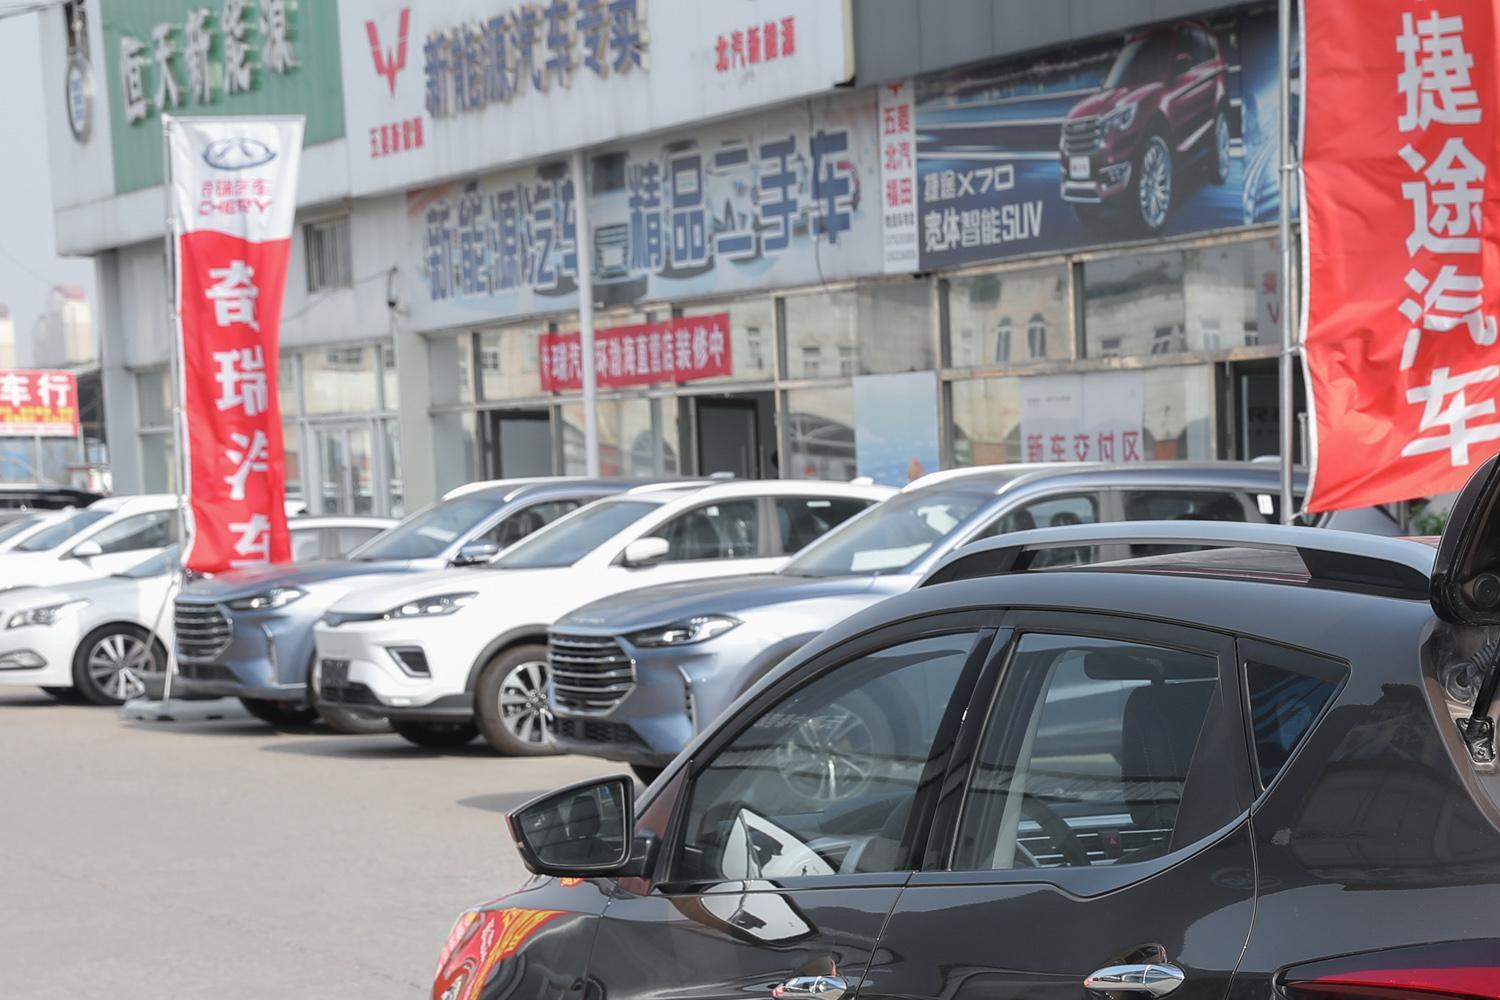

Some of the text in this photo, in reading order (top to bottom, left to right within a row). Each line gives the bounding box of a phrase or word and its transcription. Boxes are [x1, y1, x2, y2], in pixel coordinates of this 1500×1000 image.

[715, 16, 797, 73] 北汽新能源
[627, 130, 852, 272] 精品二手车
[924, 200, 1043, 252] 宽体智能SUV
[1027, 431, 1140, 463] 新车交付区
